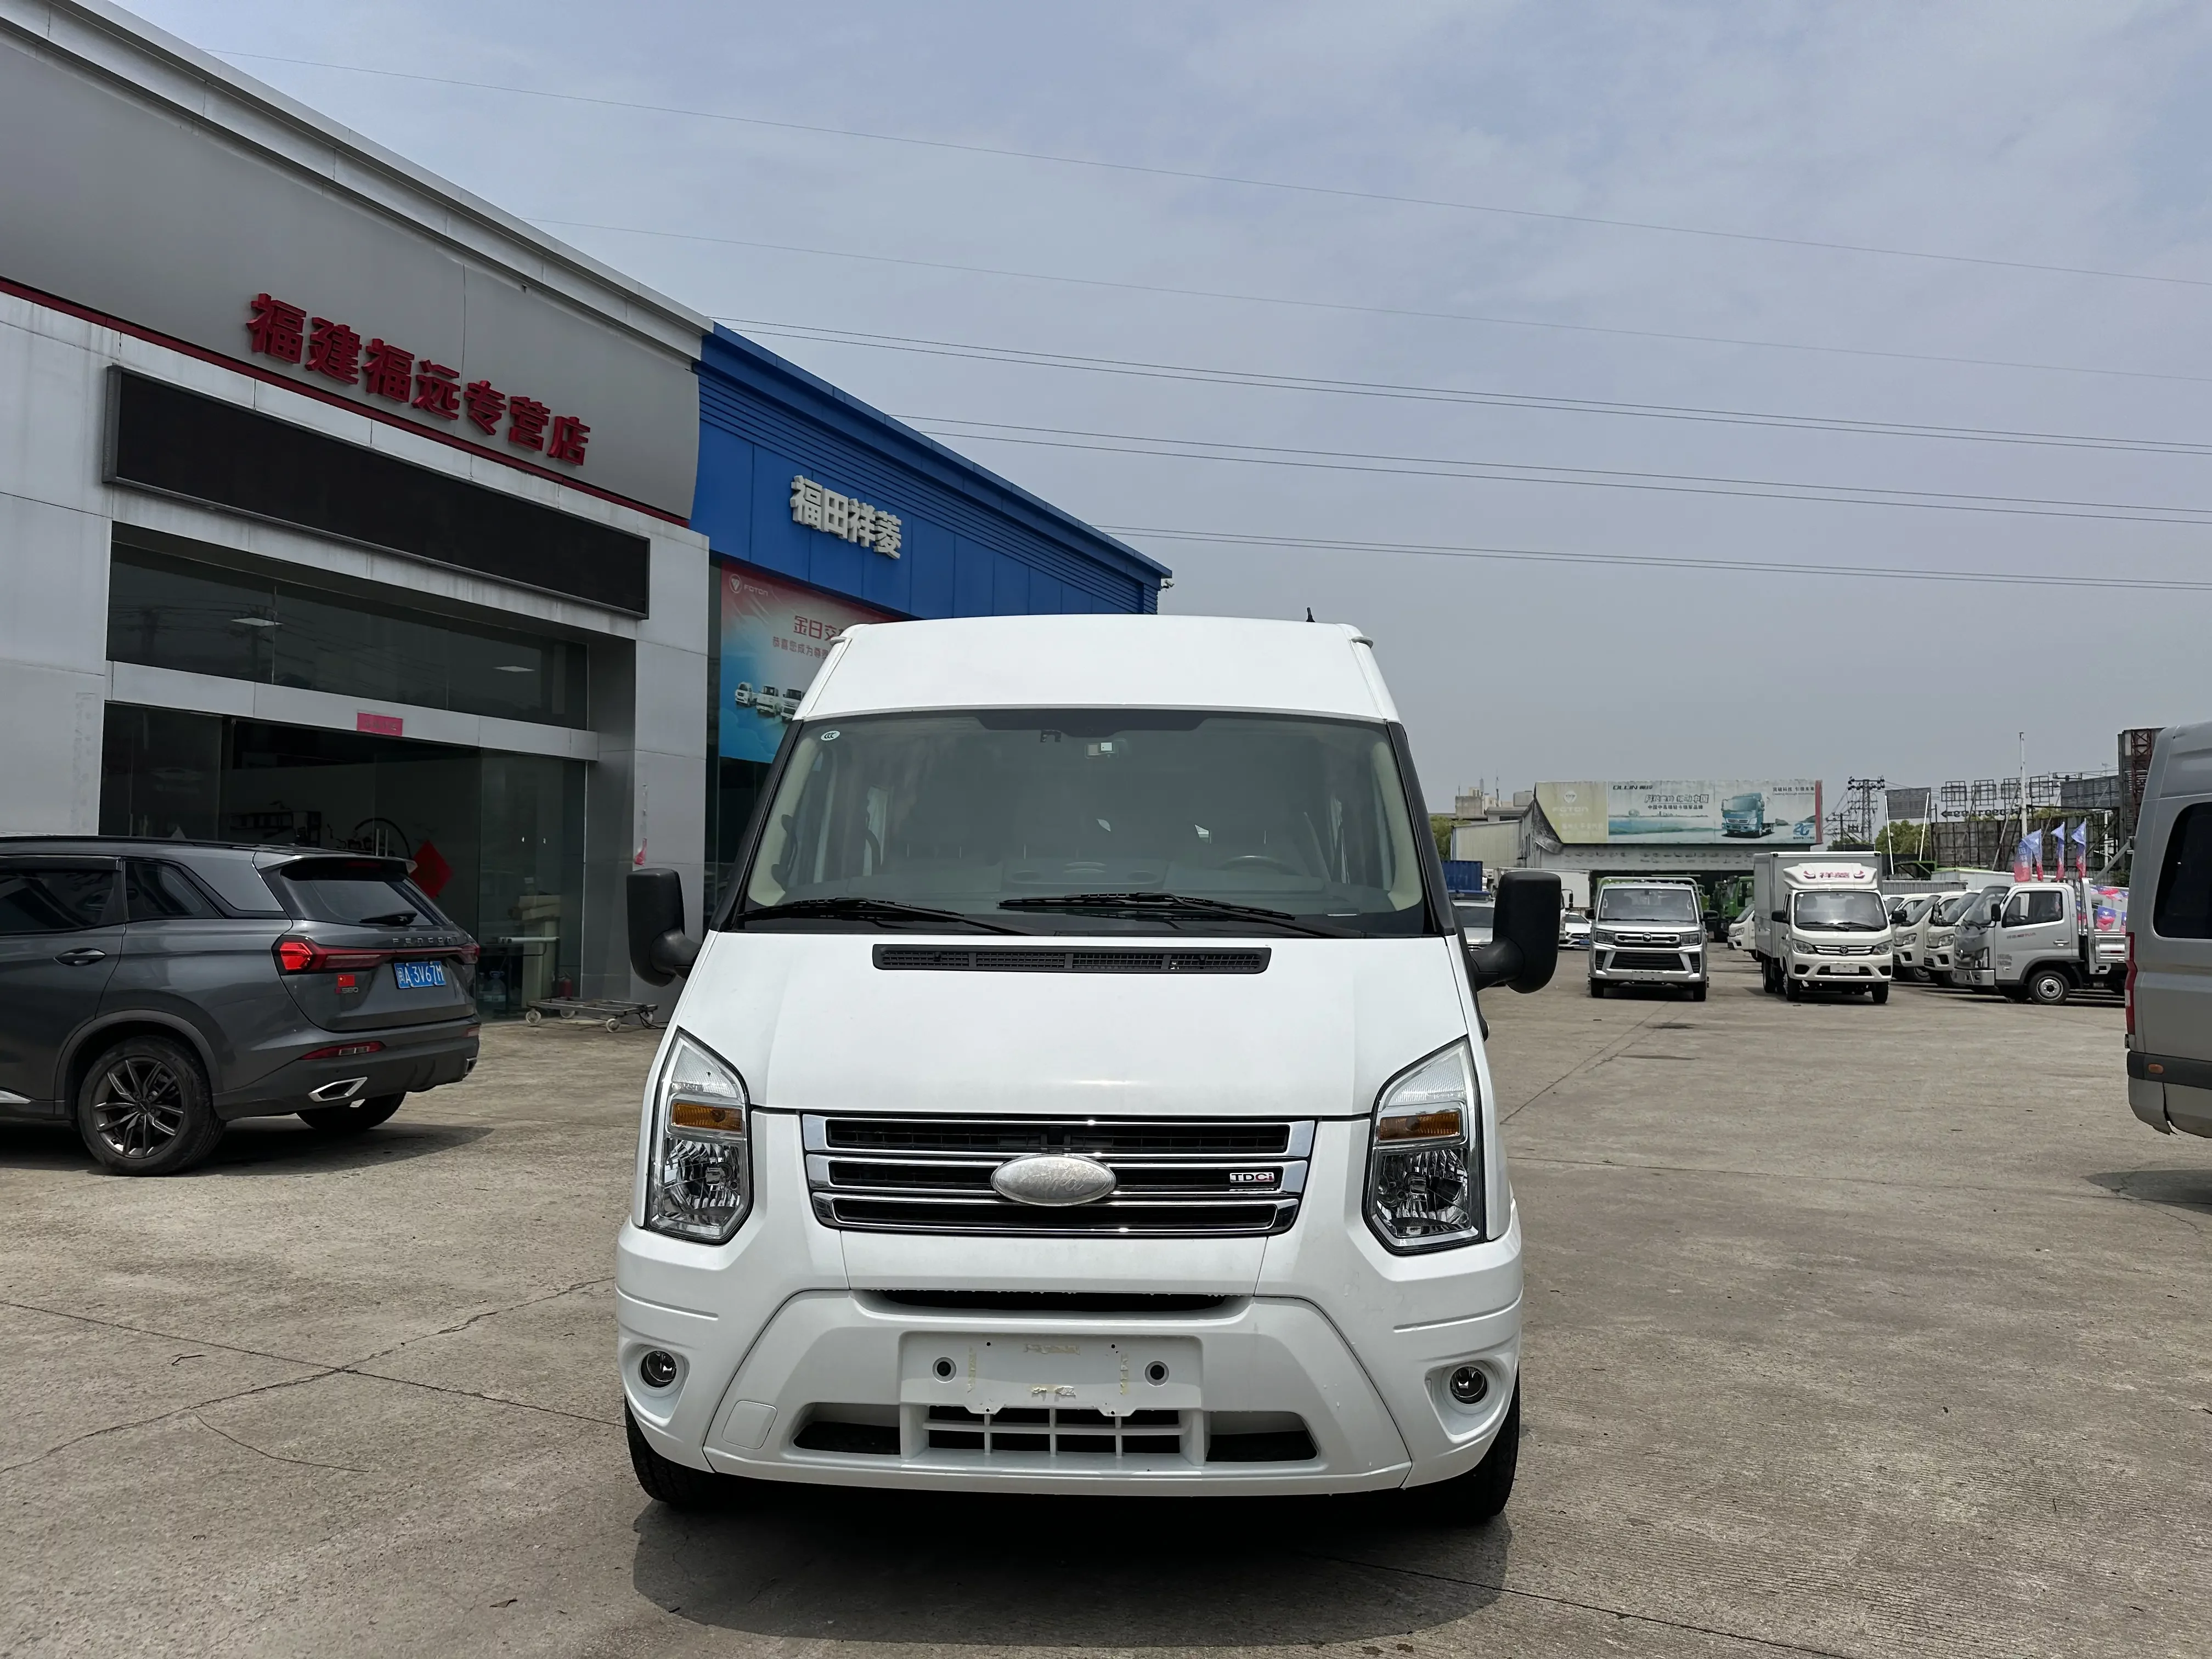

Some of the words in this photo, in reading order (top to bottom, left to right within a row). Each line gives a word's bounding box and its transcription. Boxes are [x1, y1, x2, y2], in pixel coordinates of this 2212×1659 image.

[246, 292, 591, 466] 福建福远专营店
[790, 475, 901, 559] 福田祥菱
[743, 584, 768, 596] FOTON
[793, 615, 844, 641] 金日交
[1231, 1173, 1273, 1181] TDCi
